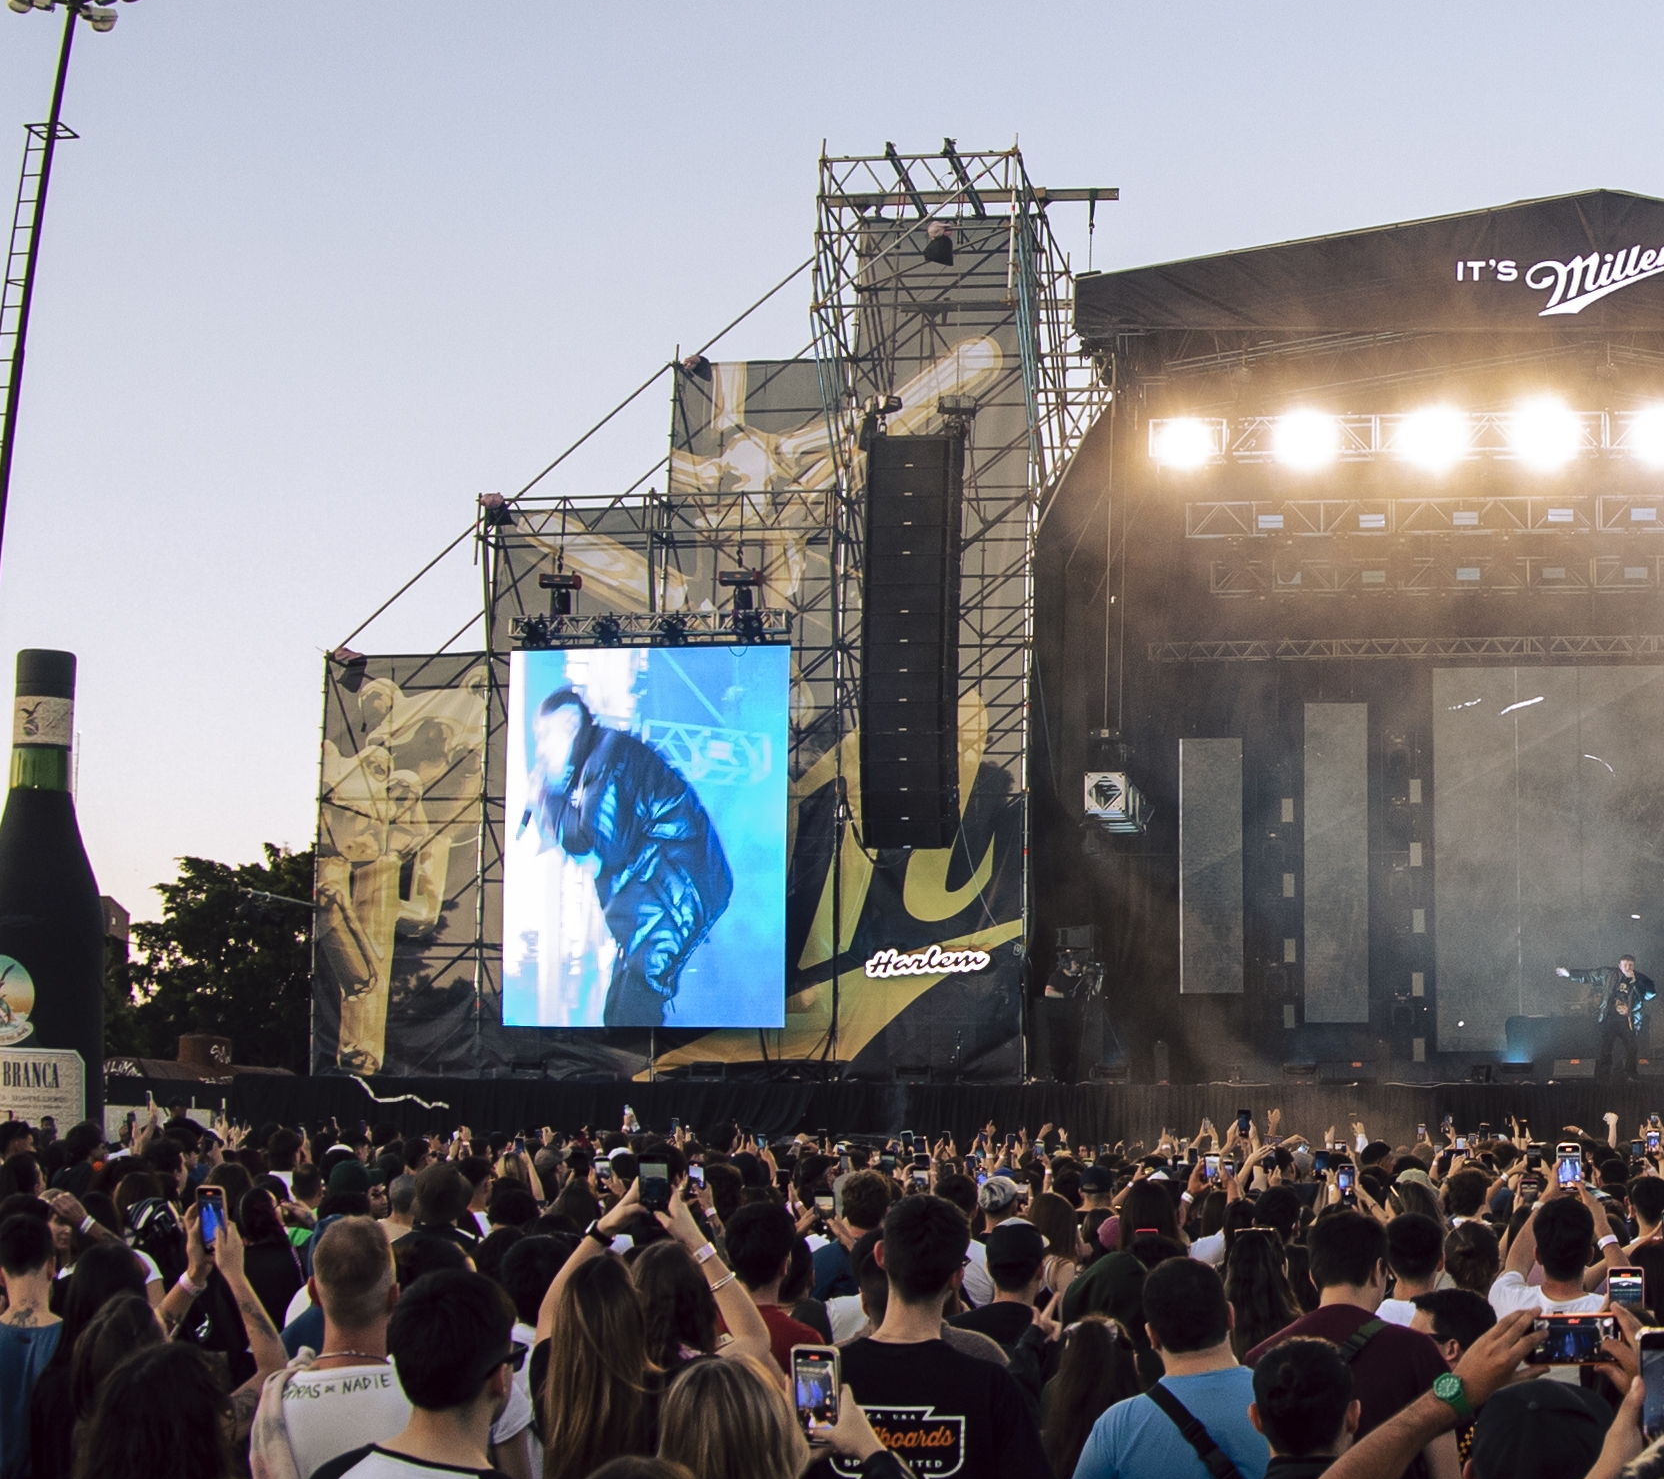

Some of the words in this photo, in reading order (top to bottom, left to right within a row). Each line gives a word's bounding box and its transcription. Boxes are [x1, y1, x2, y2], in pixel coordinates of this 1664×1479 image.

[1456, 258, 1518, 282] IT'S
[866, 946, 990, 979] Harlem
[3, 1061, 60, 1089] BRANCA
[342, 1374, 391, 1394] NADIE
